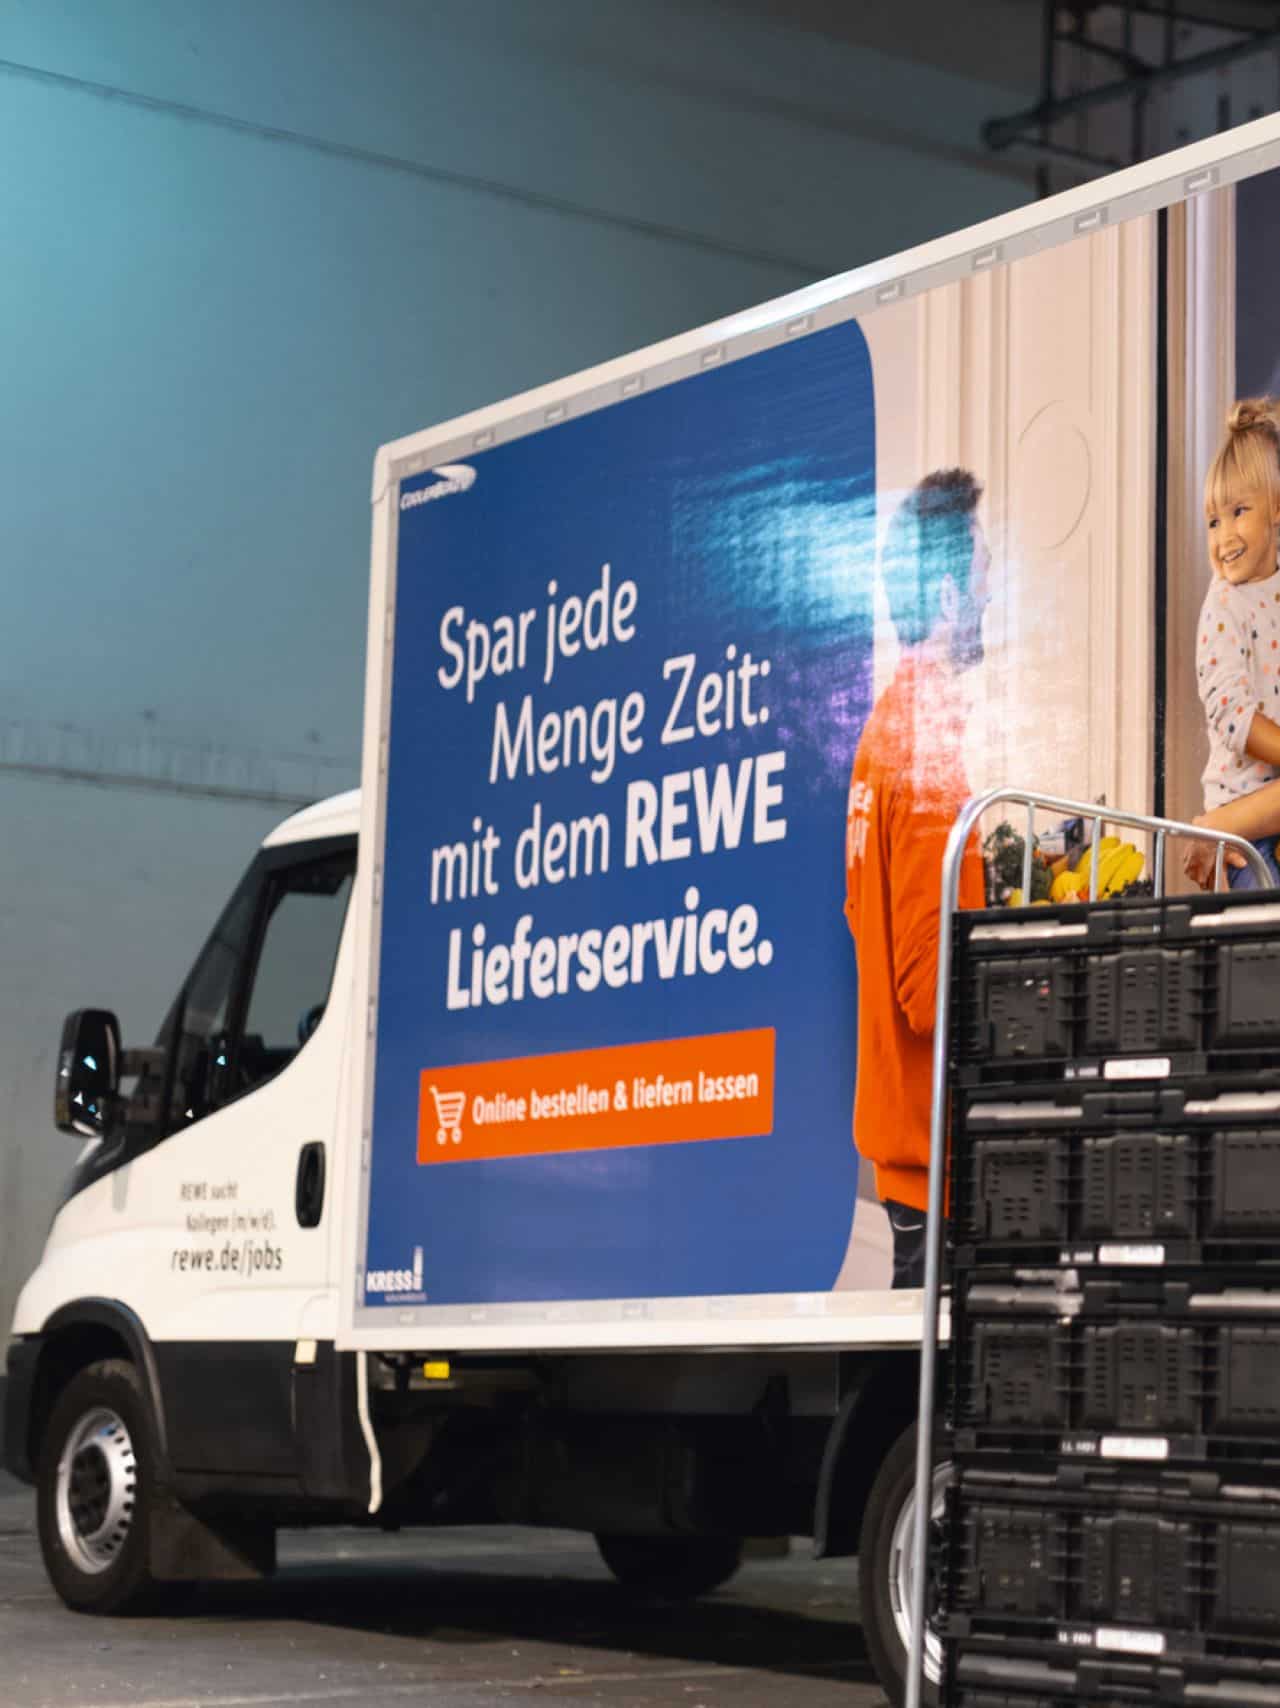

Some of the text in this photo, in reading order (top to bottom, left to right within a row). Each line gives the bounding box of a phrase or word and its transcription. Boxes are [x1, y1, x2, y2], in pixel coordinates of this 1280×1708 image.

[437, 563, 638, 703] Spar jede
[488, 643, 772, 785] Menge Zeit:
[430, 816, 501, 904] mit
[514, 802, 610, 890] dem
[624, 750, 788, 868] REWE
[446, 885, 774, 1010] Lieferservice.
[472, 1070, 760, 1125] Online bestellen & liefern lassen
[181, 1181, 207, 1200] REWE
[171, 1240, 283, 1277] rewe.de/jobs
